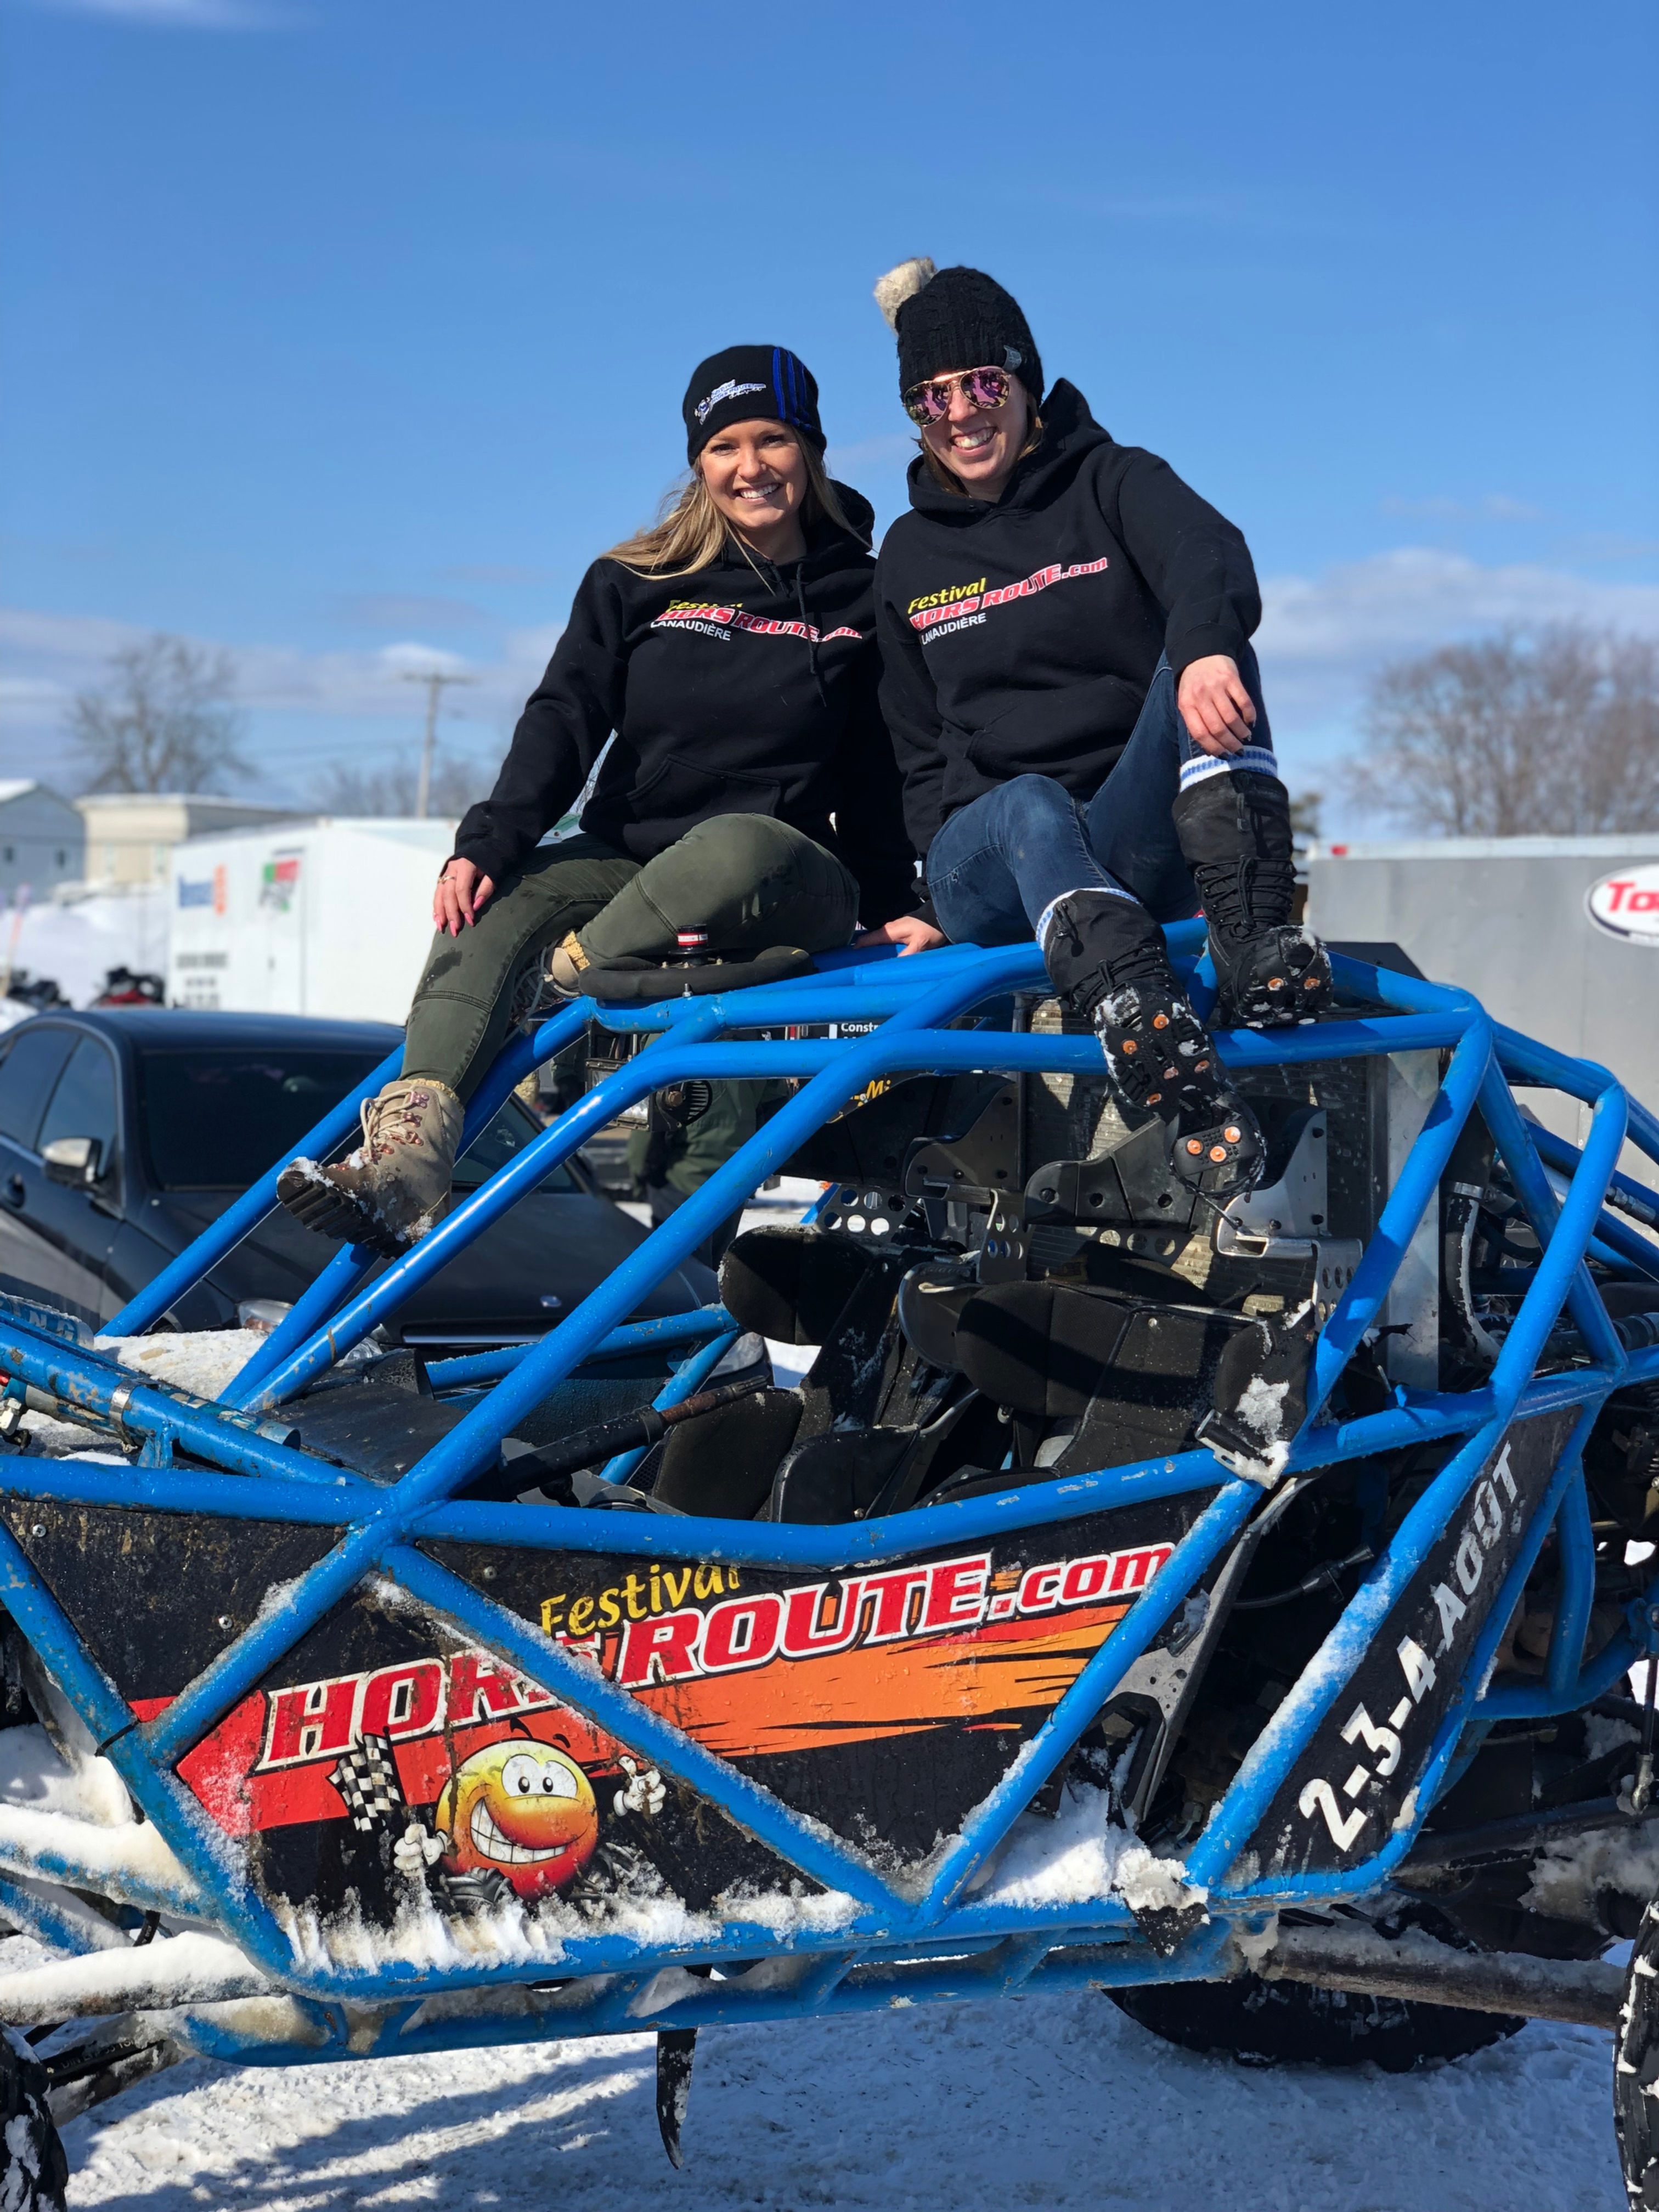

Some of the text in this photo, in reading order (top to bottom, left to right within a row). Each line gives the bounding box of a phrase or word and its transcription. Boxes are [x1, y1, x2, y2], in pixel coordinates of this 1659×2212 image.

[907, 577, 986, 614] Festival
[909, 557, 1109, 631] HORS ROUTE.com
[651, 620, 731, 641] LANAUDIÈRE
[654, 607, 736, 624] HORS
[921, 613, 988, 646] LANAUDIÈRE
[1607, 880, 1659, 913] Ta
[614, 1542, 1177, 1692] ROUTE.com
[1297, 1634, 1437, 1852] 2-3-4
